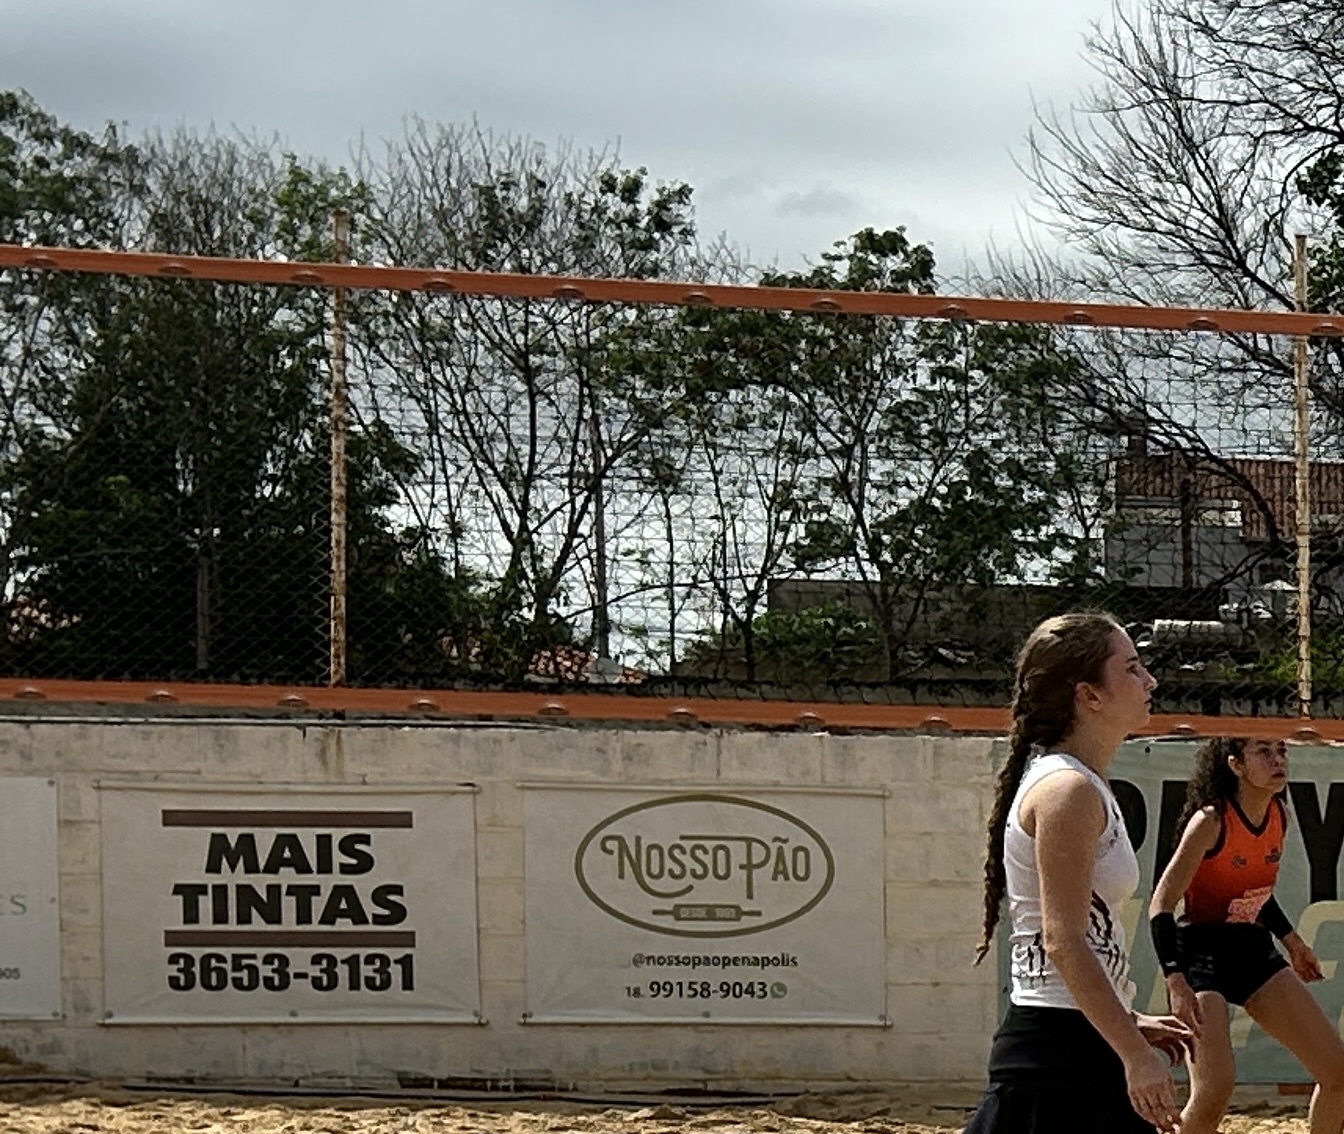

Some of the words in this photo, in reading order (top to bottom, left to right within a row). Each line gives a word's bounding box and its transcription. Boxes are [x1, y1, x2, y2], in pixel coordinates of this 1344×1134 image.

[205, 832, 375, 875] MAIS
[600, 834, 732, 898] NOSSO
[679, 834, 812, 900] PÃO
[172, 884, 407, 926] TINTAS
[167, 952, 415, 992] 3653-3131
[631, 953, 799, 970] @nossopaopenapolis
[649, 981, 769, 999] 99158-9043
